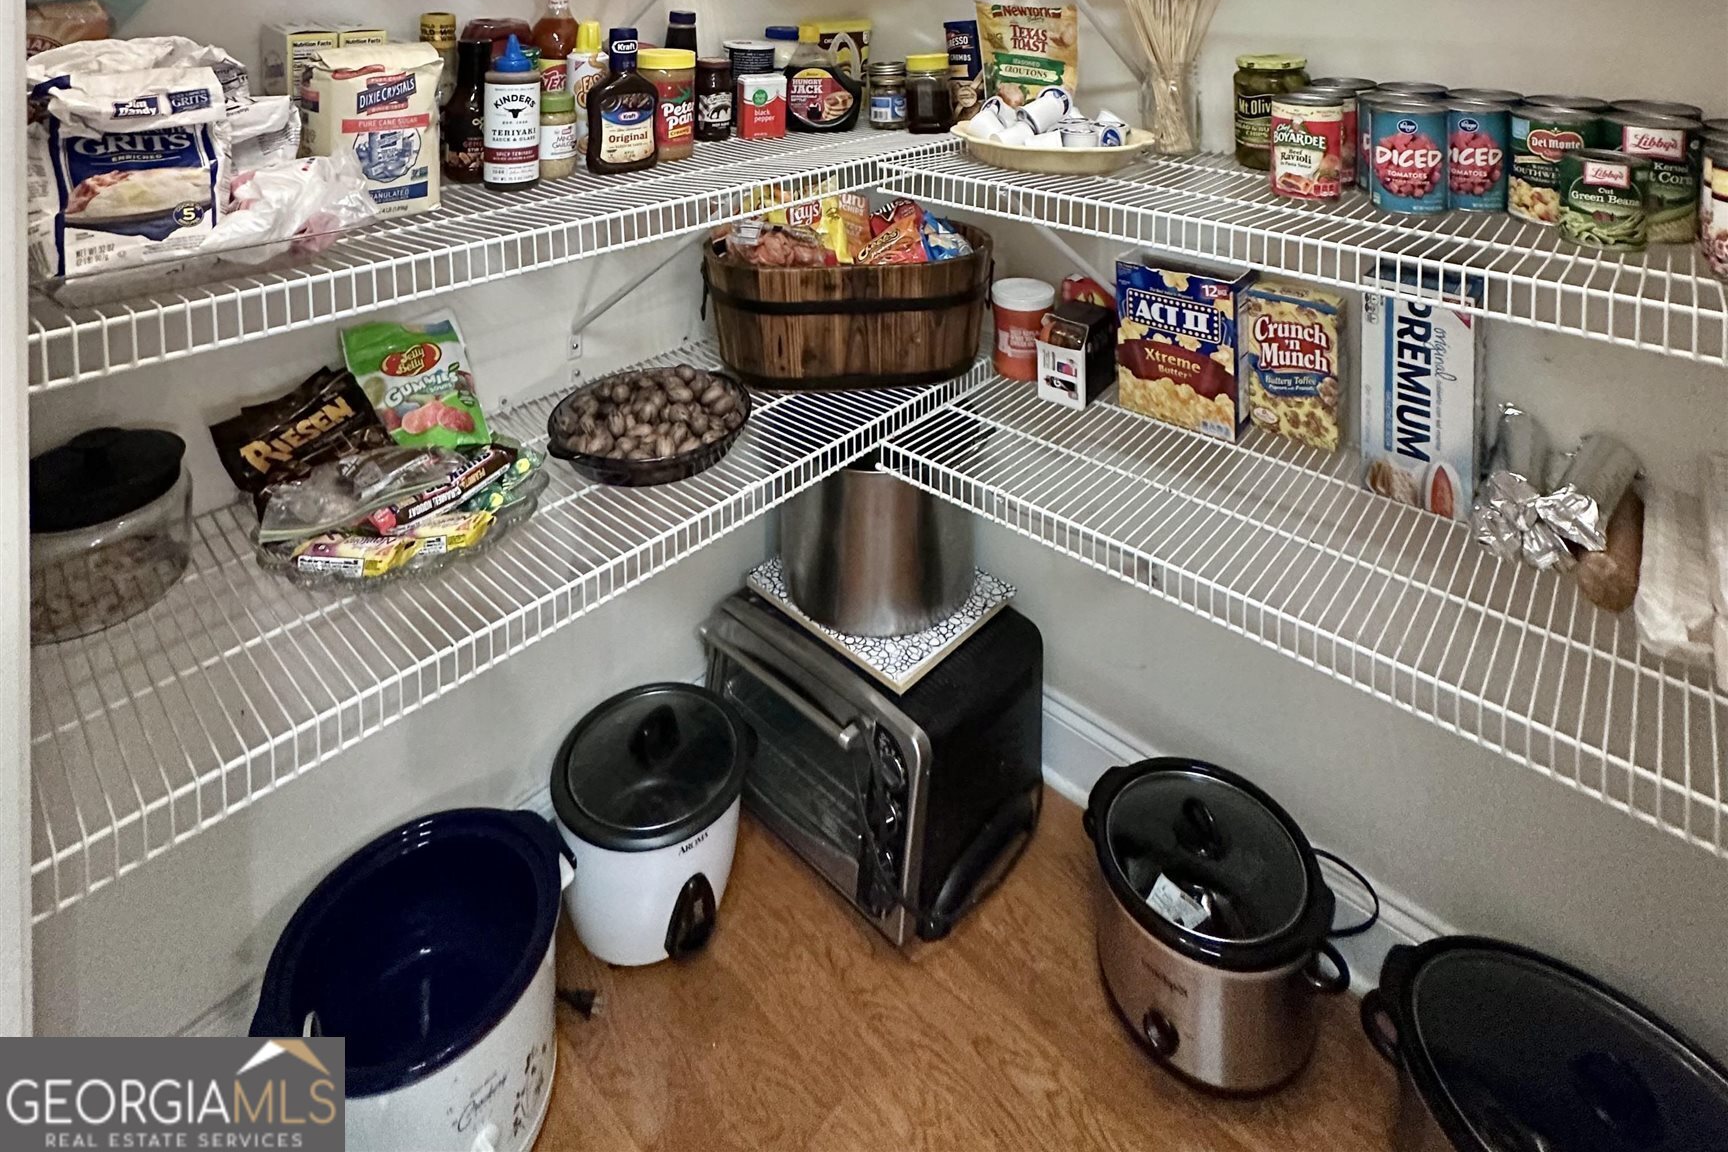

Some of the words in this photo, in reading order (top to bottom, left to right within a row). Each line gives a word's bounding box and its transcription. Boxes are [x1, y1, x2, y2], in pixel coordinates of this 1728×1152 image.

[1009, 24, 1048, 42] TEXAS
[617, 43, 635, 51] Kraft
[1010, 37, 1049, 54] TOAST
[1004, 65, 1049, 79] CROUTONS
[792, 78, 823, 86] HUNGRY
[359, 91, 381, 109] DIXIE
[381, 77, 416, 102] CRYSTALS
[791, 85, 824, 95] JACK
[125, 99, 147, 108] Jim
[171, 93, 209, 108] GRITS
[118, 106, 157, 117] Dandy
[622, 112, 637, 120] Kraft
[660, 101, 695, 118] Peter
[754, 109, 771, 117] black
[666, 112, 693, 130] Pan
[753, 115, 776, 124] pepper
[491, 128, 536, 137] TERIYAKI
[608, 131, 648, 144] Original
[1273, 131, 1326, 149] BOYARDEE
[72, 132, 191, 157] GRITS
[1531, 136, 1547, 148] Del
[1548, 139, 1582, 150] Monte
[1631, 130, 1679, 151] Libby's
[1280, 151, 1313, 165] Ravioli
[1375, 145, 1443, 169] DICED
[1386, 169, 1428, 180] TOMATOES
[1591, 166, 1625, 181] Libby's
[1657, 171, 1694, 185] Corn
[1570, 190, 1605, 204] Green
[1607, 195, 1641, 207] Beans
[1597, 187, 1614, 196] Cut
[182, 207, 196, 222] 5
[789, 202, 820, 227] Lay's
[1201, 284, 1219, 298] 12
[1135, 299, 1180, 327] ACT
[1182, 308, 1211, 335] II
[1254, 315, 1328, 349] Crunch
[1285, 339, 1301, 351] 'n
[401, 348, 425, 363] Jelly
[1143, 347, 1202, 375] Xtreme
[1260, 342, 1329, 374] Munch
[1423, 326, 1458, 383] original
[396, 358, 425, 375] Belly
[1157, 363, 1188, 380] Butter
[1395, 301, 1433, 464] PREMIUM
[239, 397, 357, 474] RIESEN
